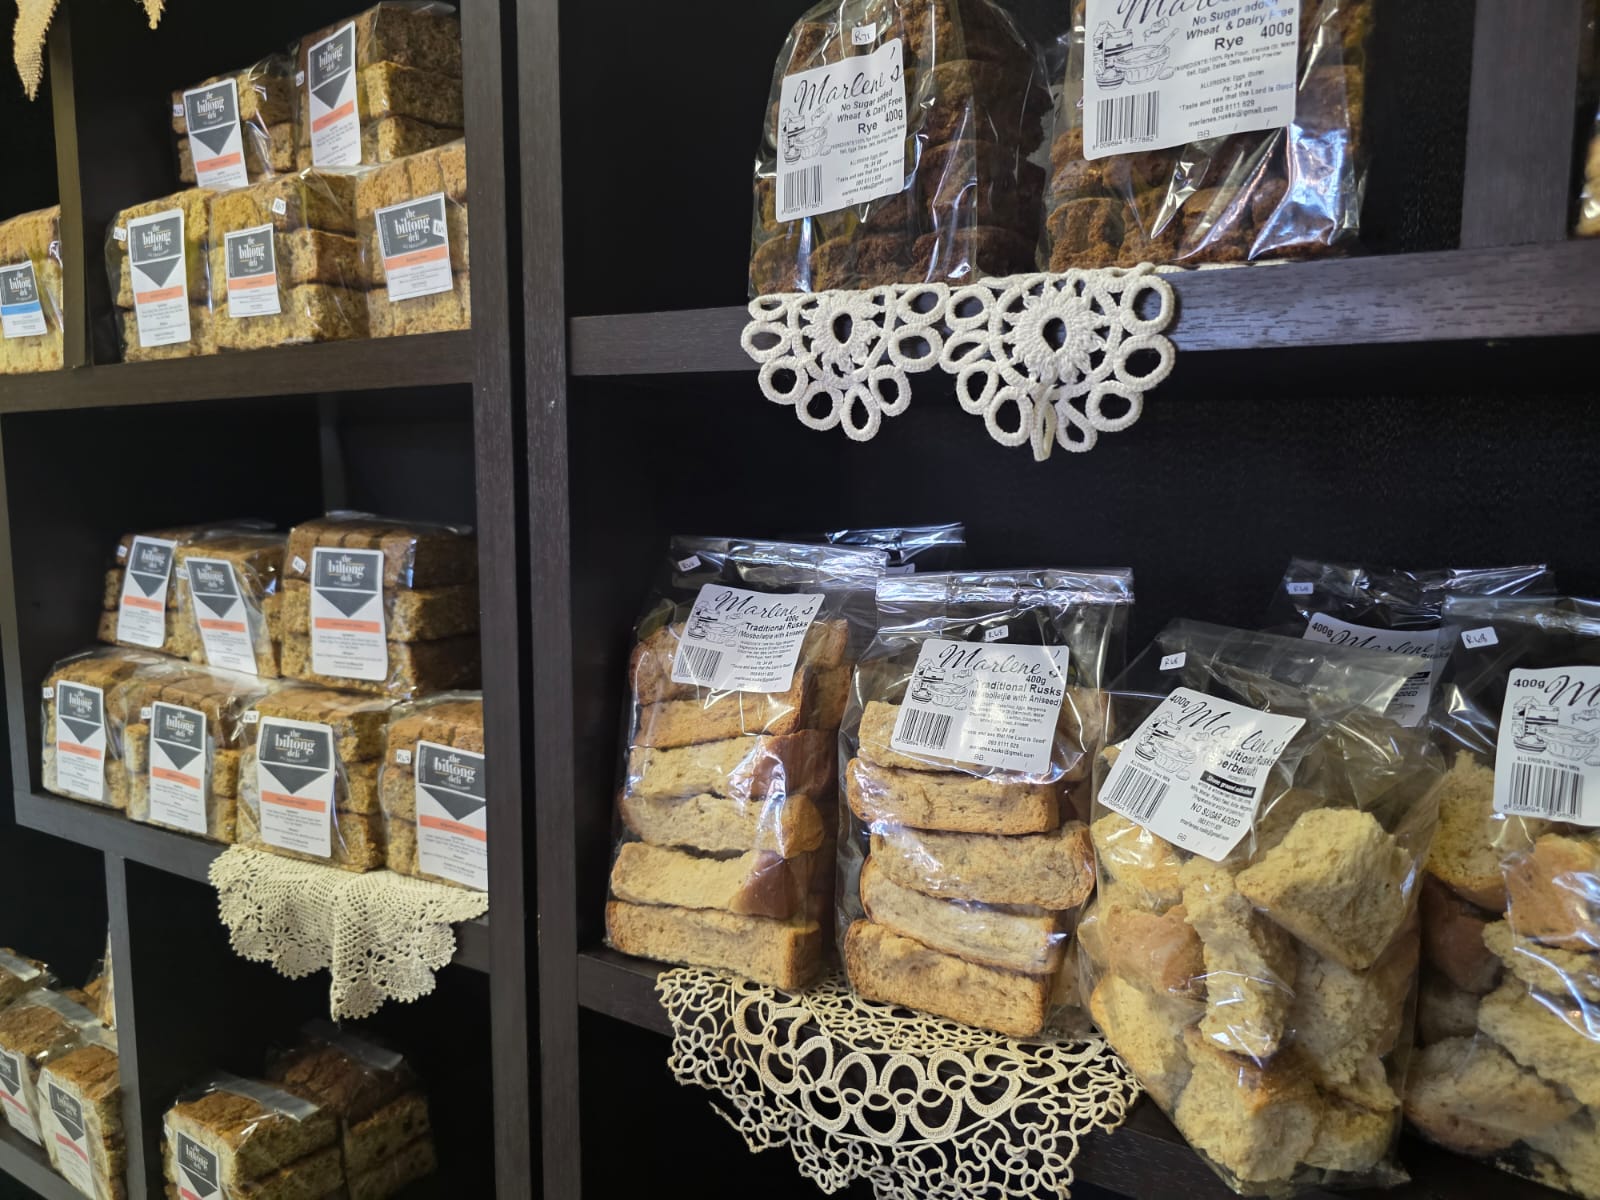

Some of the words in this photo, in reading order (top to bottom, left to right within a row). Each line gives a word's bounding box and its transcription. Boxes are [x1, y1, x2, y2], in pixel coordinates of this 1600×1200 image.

[1186, 26, 1220, 40] Wheat
[1226, 21, 1233, 31] &
[1237, 14, 1265, 29] Dairy
[1269, 7, 1294, 20] Fee
[1192, 15, 1206, 26] No
[1210, 7, 1241, 22] Sugar
[854, 31, 870, 42] R71
[1260, 22, 1293, 39] 400g
[1214, 35, 1244, 51] Rye
[837, 111, 861, 122] Wheat
[888, 96, 903, 108] Free
[841, 103, 851, 112] No
[853, 97, 876, 110] Sugar
[885, 108, 904, 122] 400g
[858, 121, 878, 134] Rye
[394, 217, 431, 234] biltong
[714, 591, 816, 619] Marlene's
[746, 622, 785, 632] Traditional
[1311, 622, 1334, 638] 400g
[938, 644, 1062, 678] Marlene's
[1025, 675, 1047, 685] 400g
[1513, 678, 1545, 689] 400g
[1029, 684, 1062, 696] Rusks
[1169, 695, 1190, 709] 400g
[1177, 701, 1297, 755] Malene's
[275, 733, 316, 756] biltong
[433, 757, 476, 784] biltong
[1190, 802, 1202, 813] NO
[1202, 807, 1222, 820] SUGAR
[1222, 815, 1241, 828] ADDED
